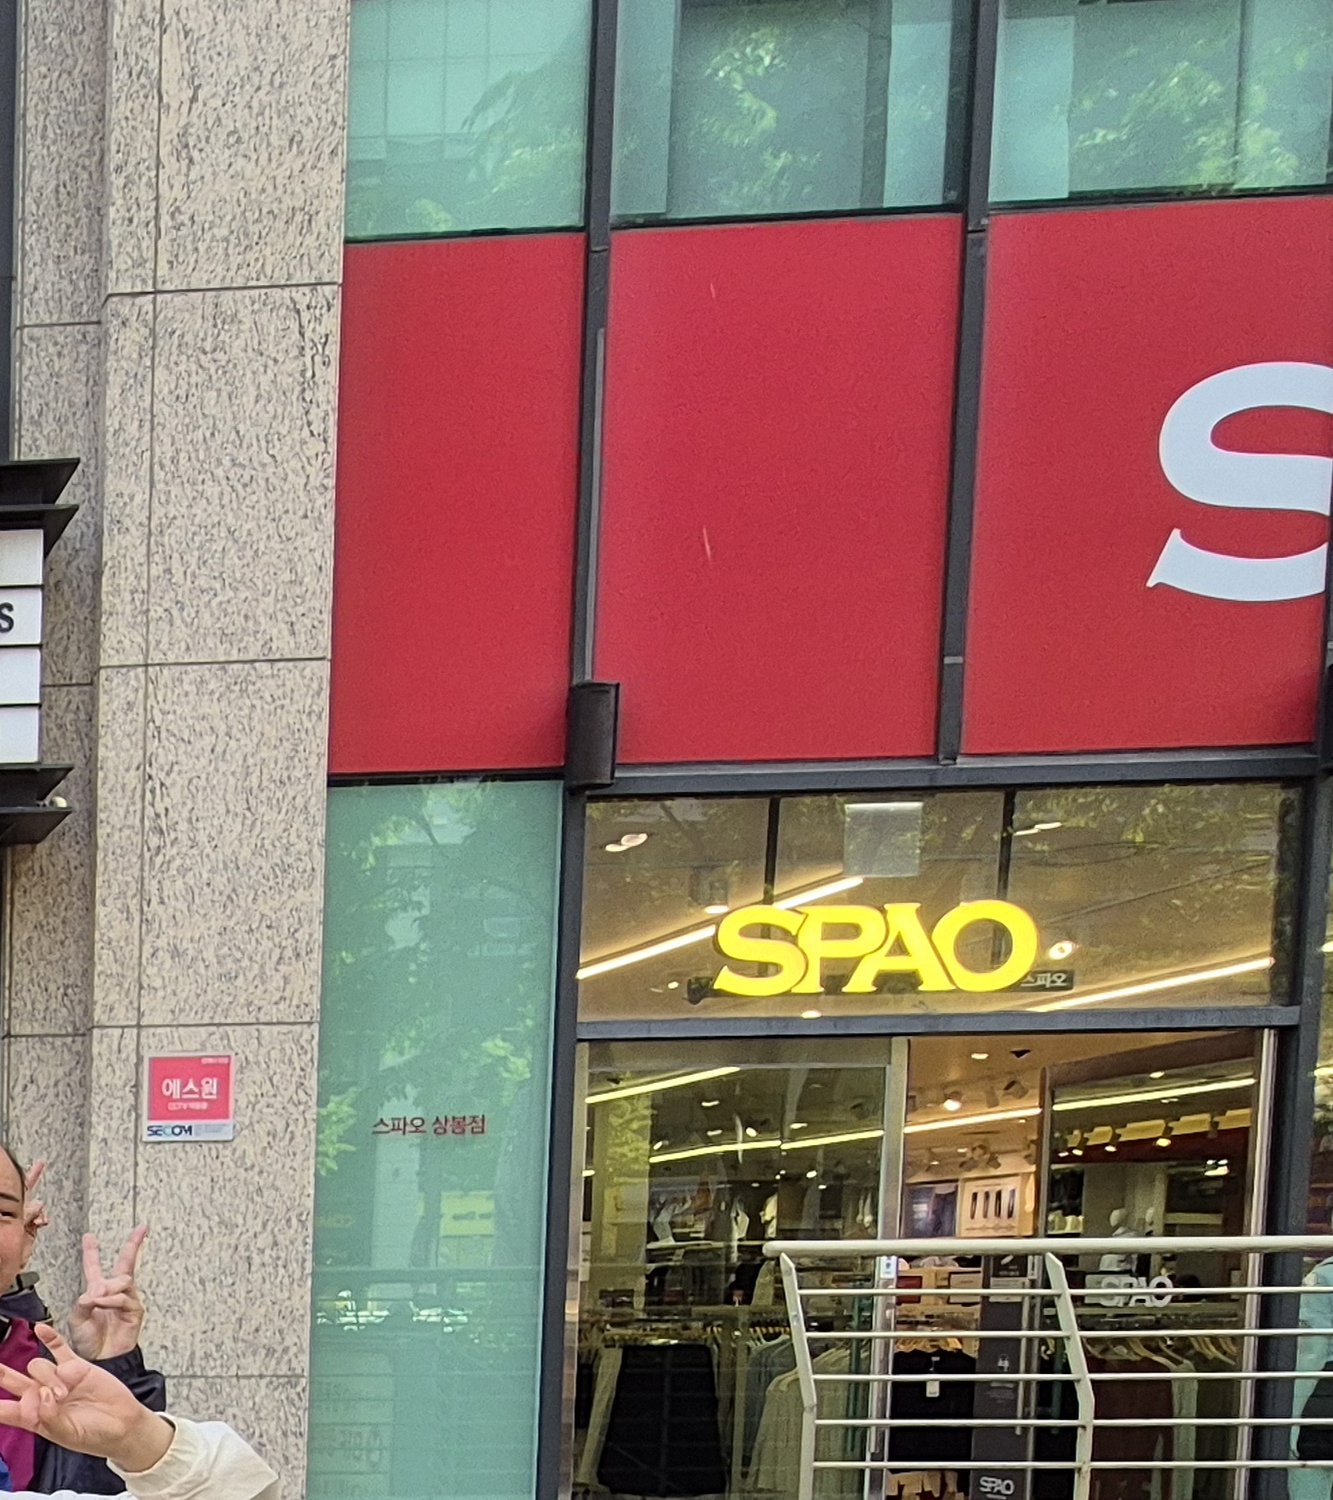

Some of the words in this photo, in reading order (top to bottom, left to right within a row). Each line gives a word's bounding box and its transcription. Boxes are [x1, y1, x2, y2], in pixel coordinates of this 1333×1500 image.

[713, 899, 1039, 997] SPAO
[1020, 972, 1068, 988] 스파오
[161, 1077, 218, 1100] 에스원
[146, 1124, 193, 1137] SECOM
[371, 1115, 427, 1136] 스파오
[431, 1113, 488, 1136] 상봉점
[1100, 1274, 1174, 1308] SPAO
[979, 1475, 1015, 1496] SPAO
